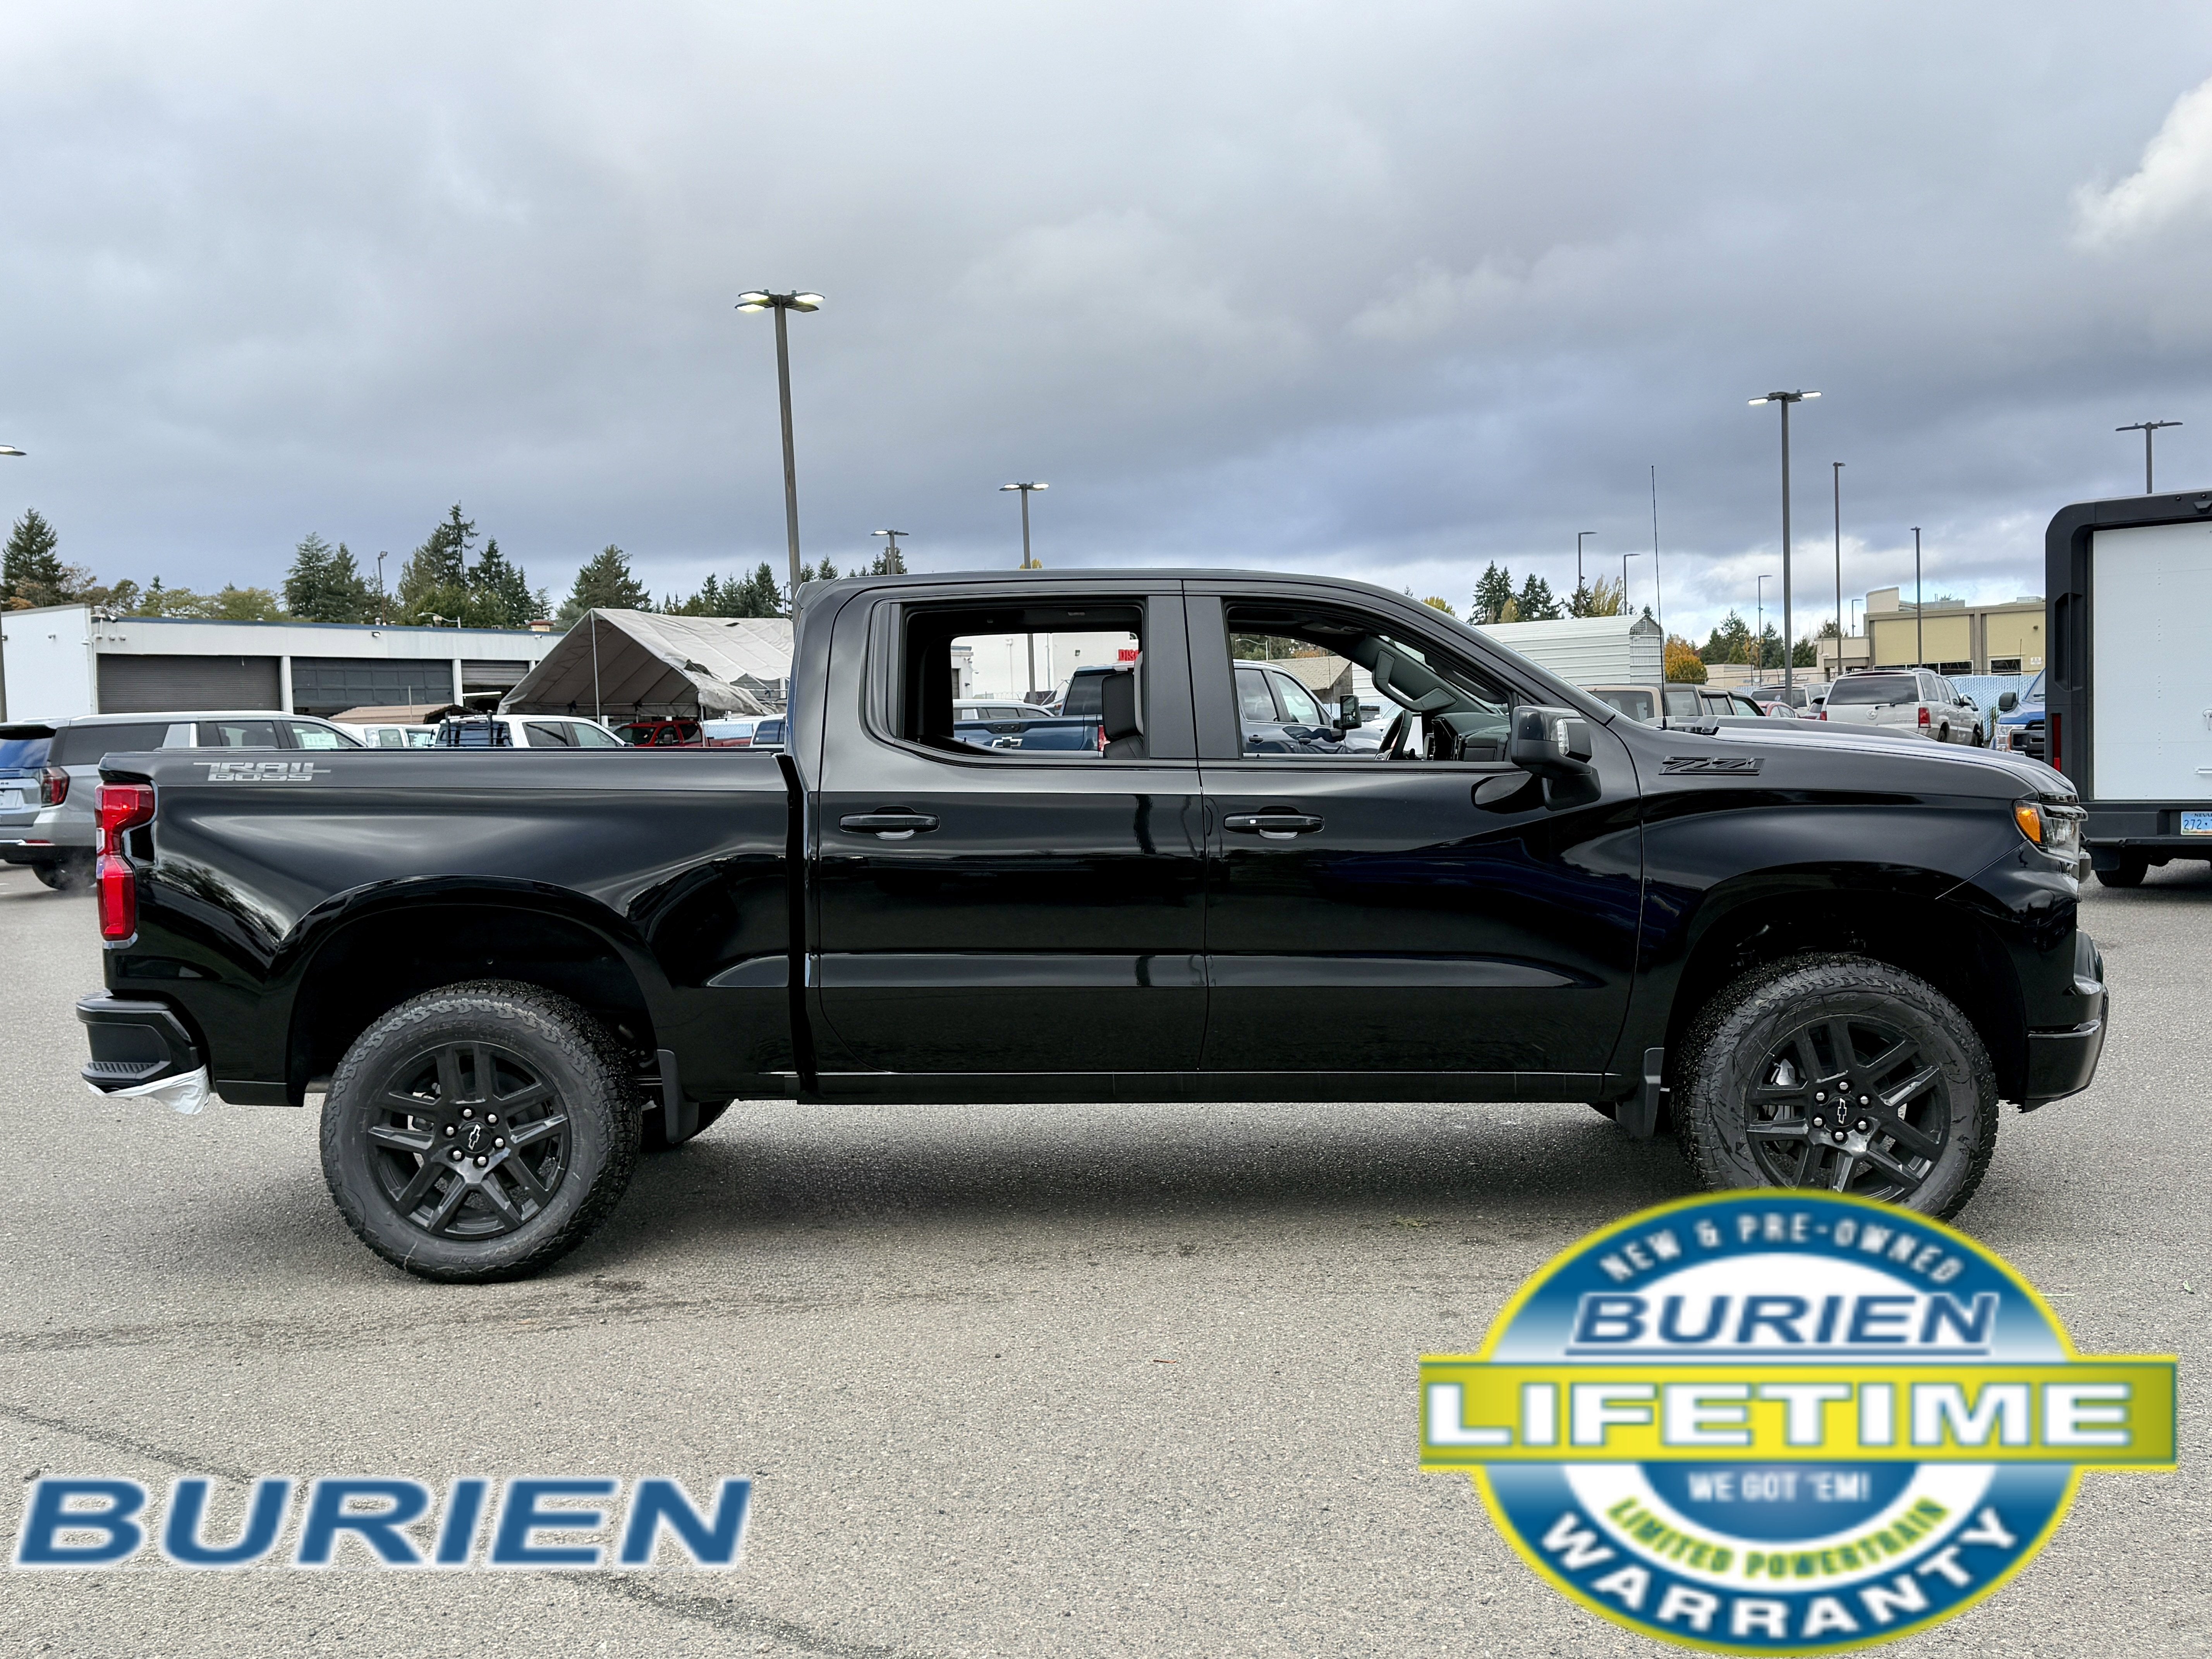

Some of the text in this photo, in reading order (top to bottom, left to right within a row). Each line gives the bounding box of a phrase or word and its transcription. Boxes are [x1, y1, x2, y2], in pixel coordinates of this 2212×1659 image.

[194, 762, 330, 773] TRAIL
[1658, 756, 1765, 776] Z71
[208, 772, 313, 781] BOSS
